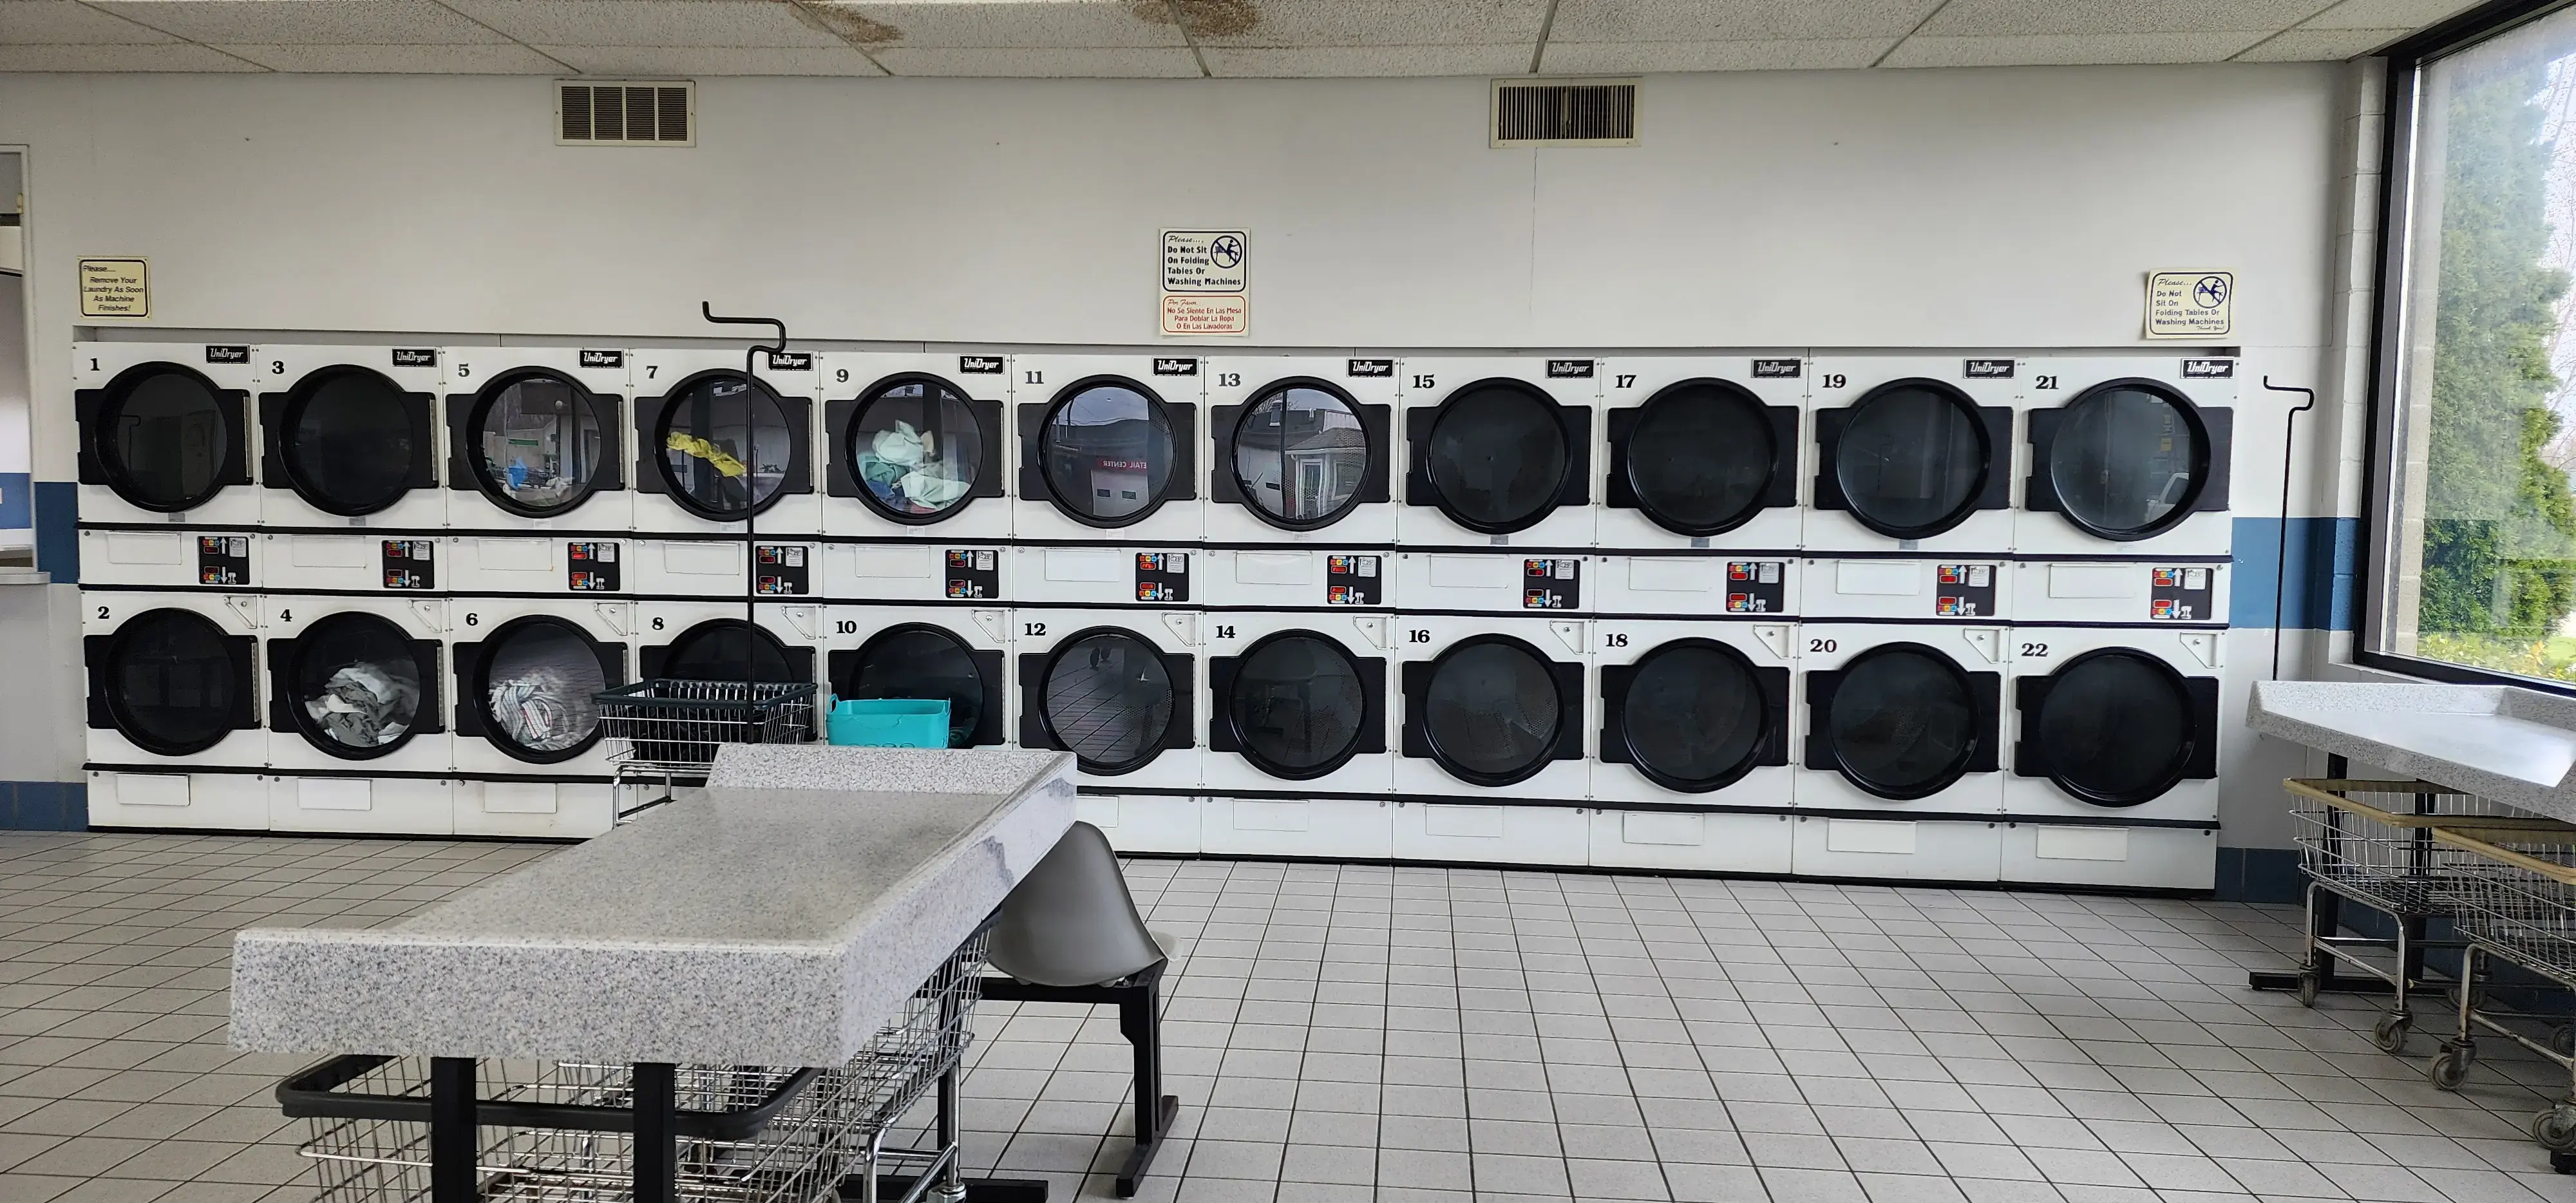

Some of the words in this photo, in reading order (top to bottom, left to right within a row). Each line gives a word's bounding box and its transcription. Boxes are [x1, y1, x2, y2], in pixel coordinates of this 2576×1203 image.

[1180, 256, 1209, 265] Folding
[1168, 278, 1202, 287] Washing
[211, 348, 243, 359] UniDryer
[397, 352, 431, 363] UniDryer
[584, 352, 619, 363] UniDryer
[91, 358, 100, 371] 1
[773, 355, 807, 366] UniDryer
[964, 358, 999, 370] UniDryer
[1158, 360, 1193, 372] UniDryer
[1353, 361, 1388, 373] UniDryer
[272, 361, 284, 374] 3
[459, 363, 469, 377] 5
[647, 366, 658, 379] 7
[1552, 363, 1589, 374] UniDryer
[1758, 362, 1796, 374] UniDryer
[1970, 362, 2009, 374] UniDryer
[2187, 361, 2229, 374] UniDryer
[837, 369, 849, 383] 9
[1026, 371, 1044, 384] 11
[1219, 374, 1240, 386] 13
[1413, 374, 1434, 388] 15
[1616, 375, 1636, 388] 17
[1823, 374, 1846, 388] 19
[2036, 375, 2058, 389] 21
[98, 607, 109, 619] 2
[280, 609, 292, 621] 4
[466, 613, 478, 626] 6
[652, 618, 664, 630] 8
[837, 621, 857, 634] 10
[1025, 623, 1046, 636] 12
[1217, 625, 1236, 638] 14
[1409, 630, 1430, 643] 16
[1606, 634, 1627, 647] 18
[1810, 639, 1837, 652] 20
[2022, 643, 2048, 656] 22
